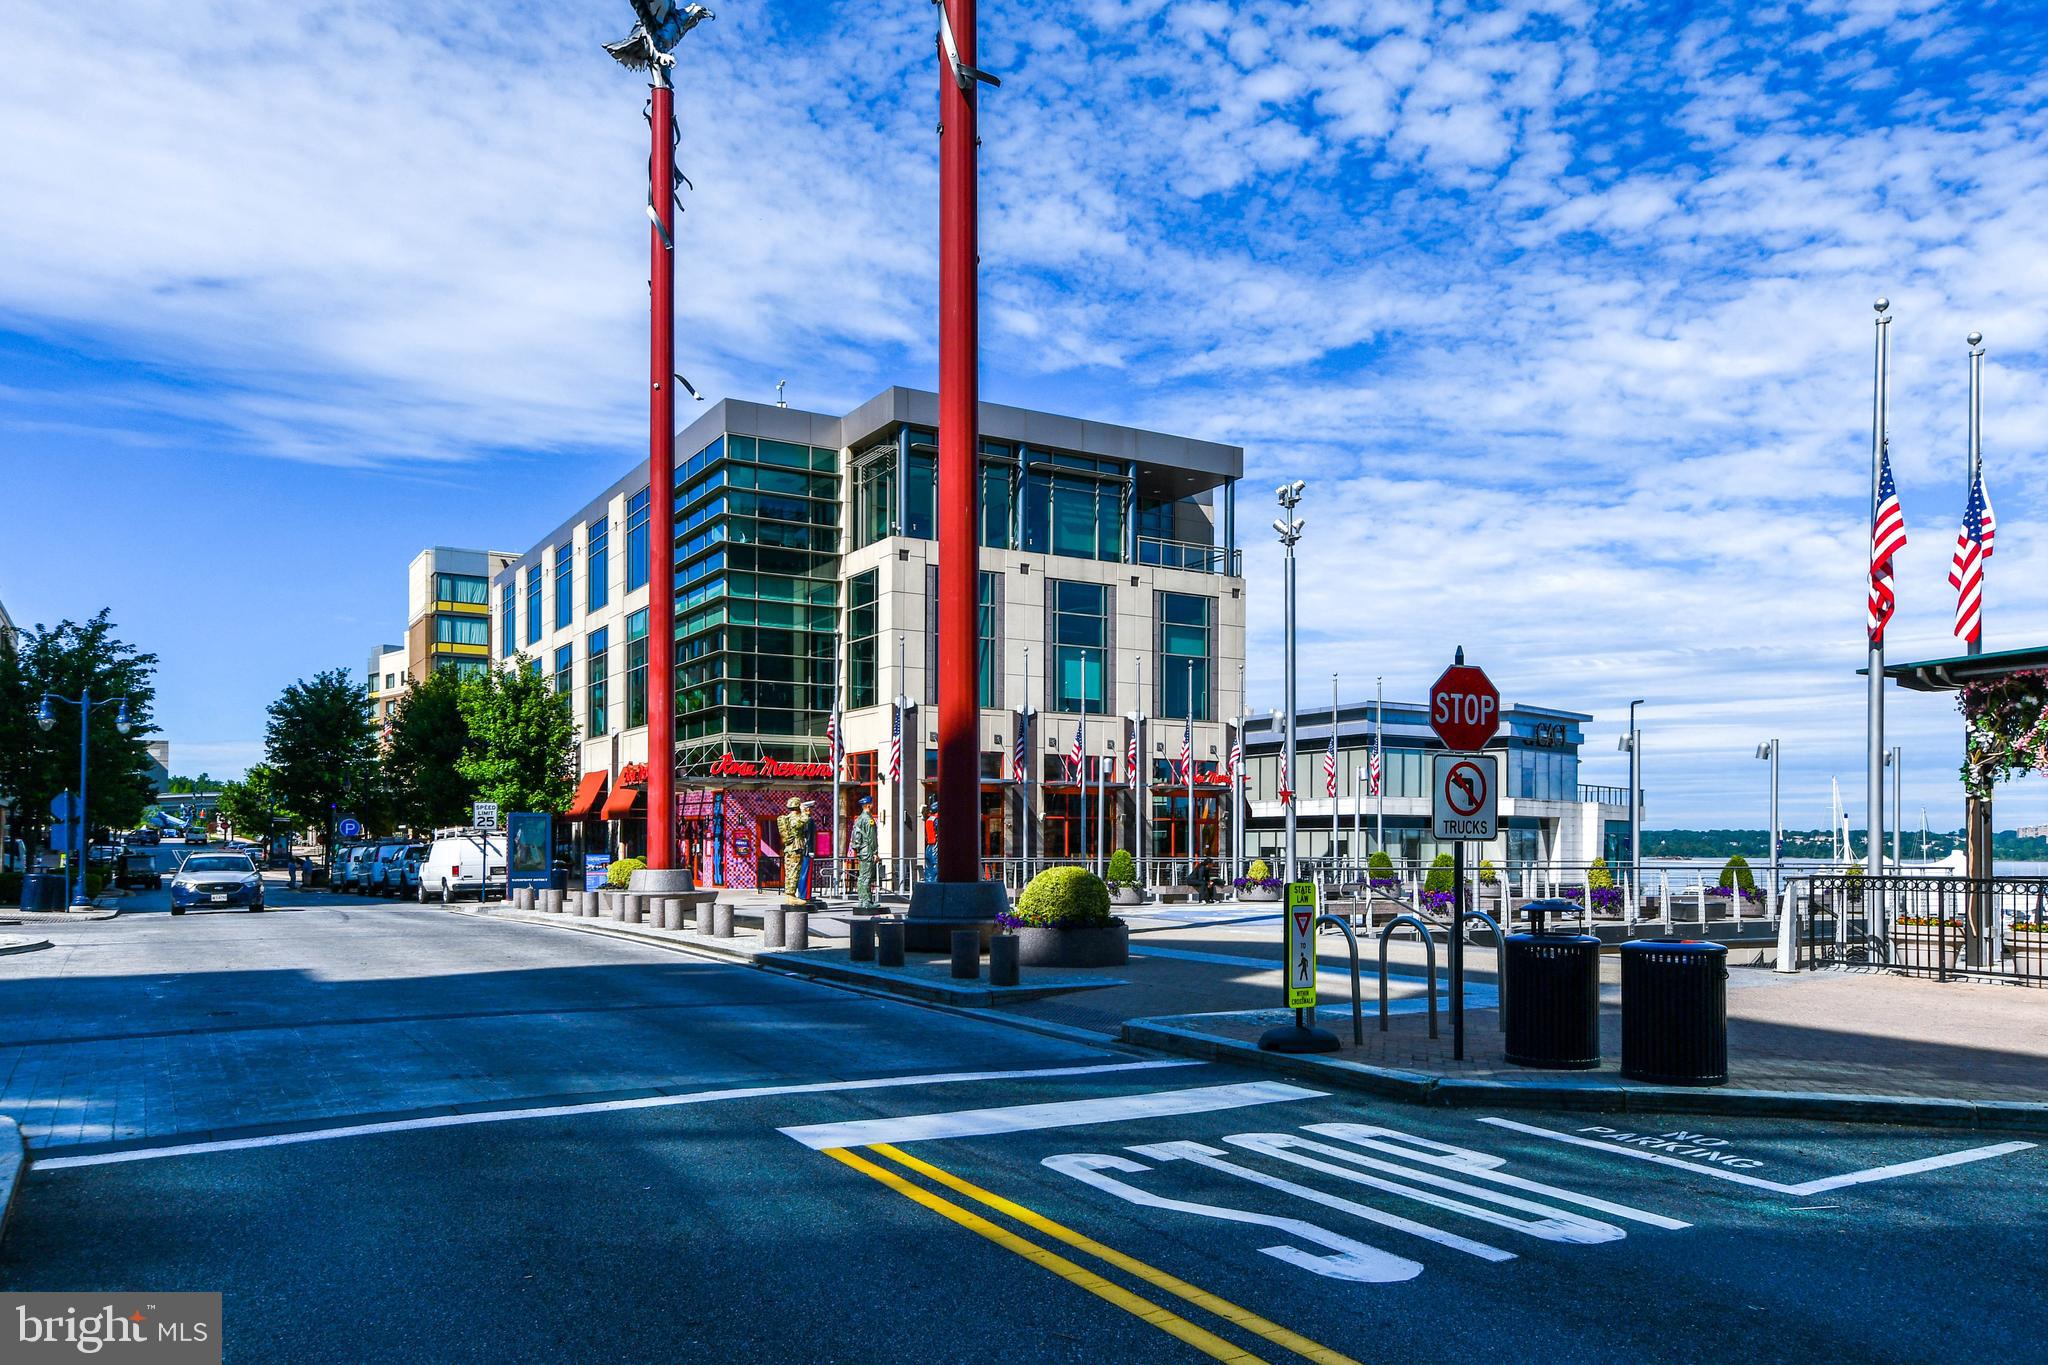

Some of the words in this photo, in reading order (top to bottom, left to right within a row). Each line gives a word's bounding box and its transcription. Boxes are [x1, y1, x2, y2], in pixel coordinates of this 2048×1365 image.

[1435, 692, 1495, 726] STOP
[710, 752, 758, 776] Rosa
[345, 823, 356, 834] P
[477, 817, 495, 827] 25
[1443, 820, 1488, 834] TRUCKS
[1296, 895, 1308, 903] LAW
[1661, 1131, 1730, 1146] NO
[1576, 1126, 1764, 1168] PARKING
[1040, 1122, 1694, 1283] STOP
